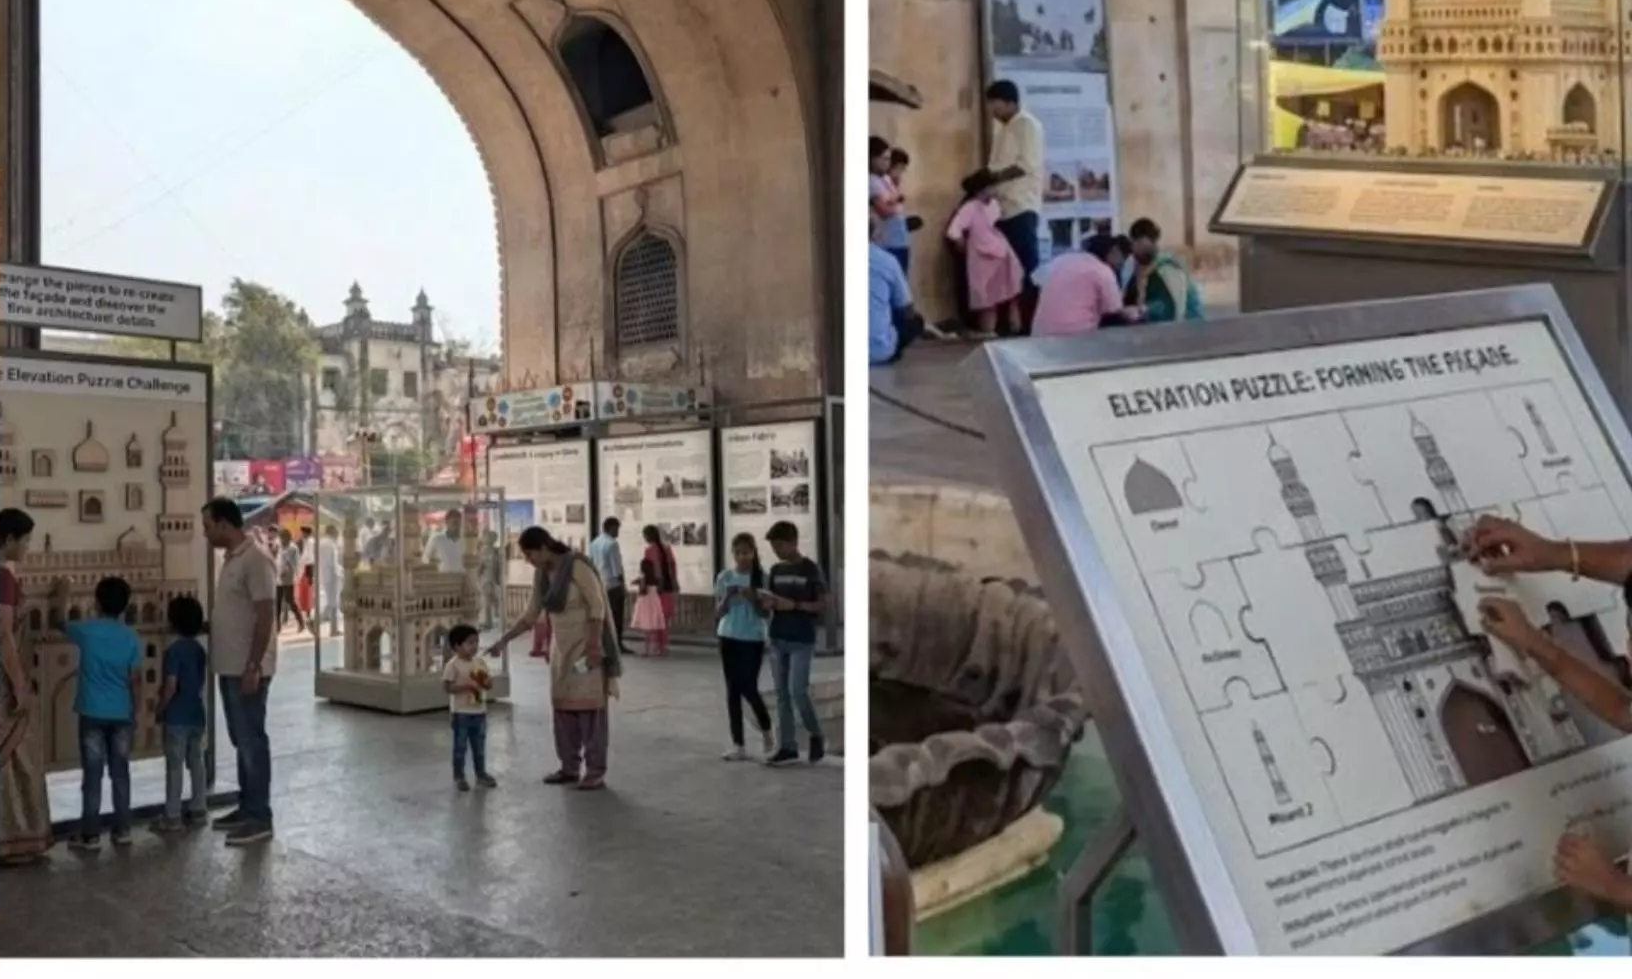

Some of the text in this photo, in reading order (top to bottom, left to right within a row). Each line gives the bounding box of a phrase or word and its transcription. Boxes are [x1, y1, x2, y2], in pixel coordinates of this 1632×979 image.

[6, 367, 74, 385] Elevation
[126, 376, 191, 394] Challenge
[1107, 381, 1229, 418] ELEVATION
